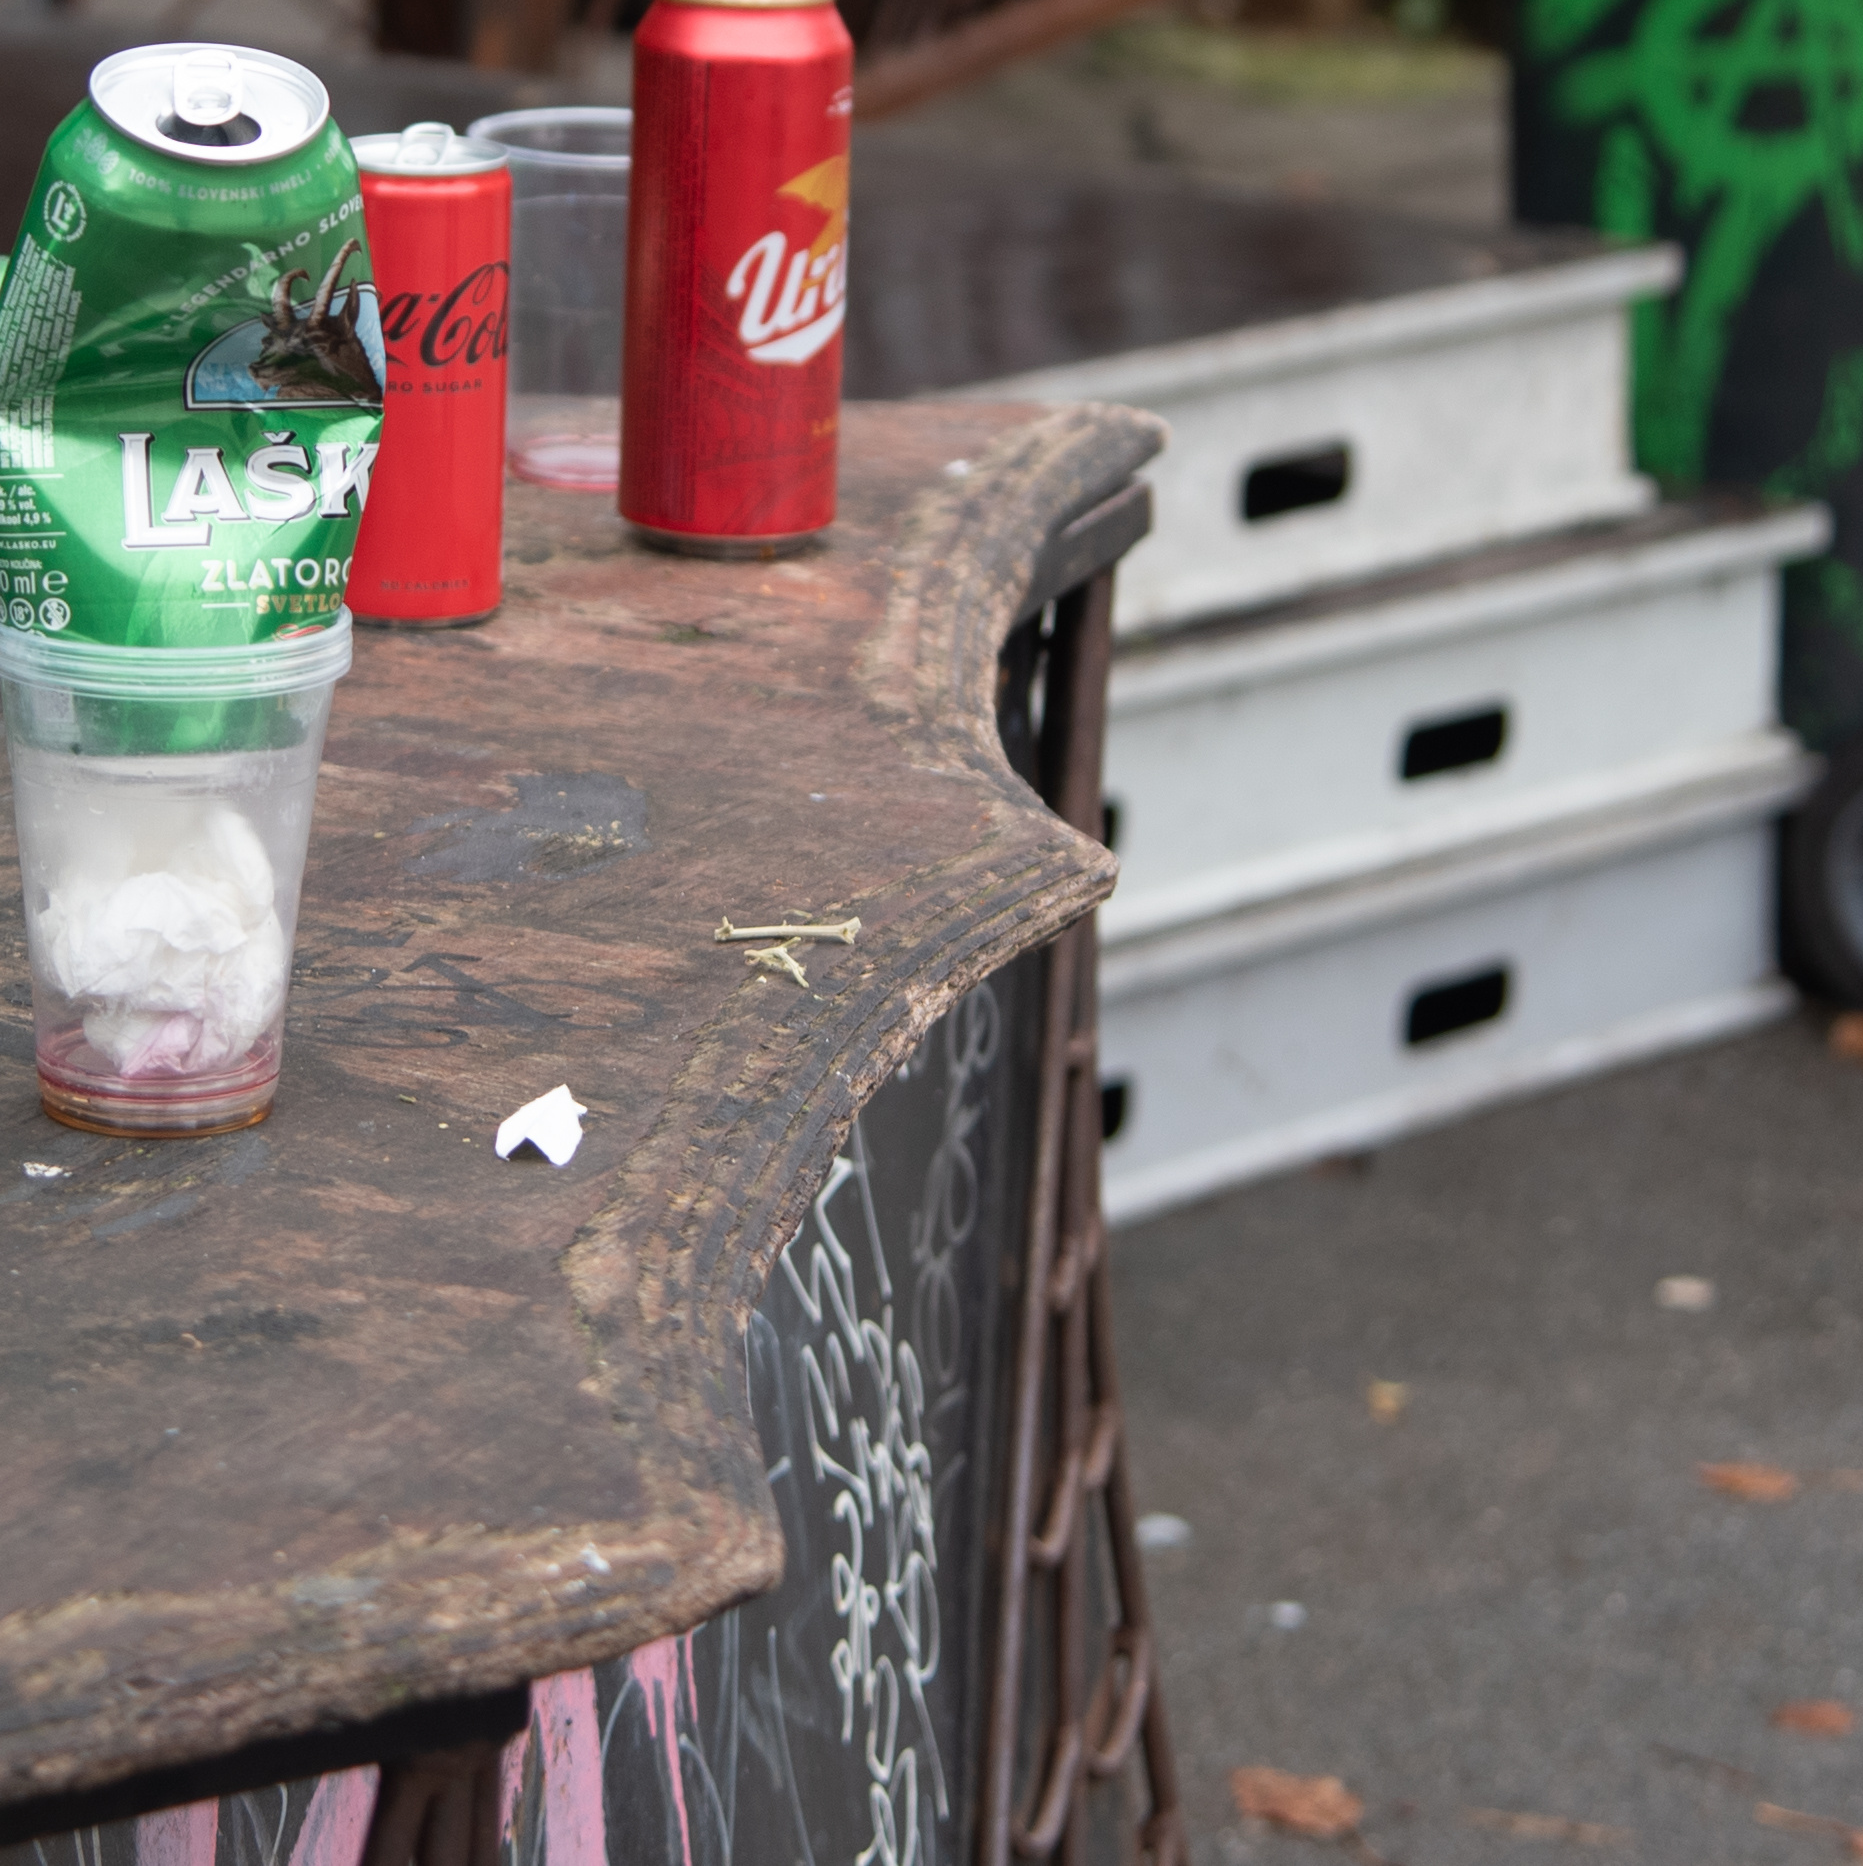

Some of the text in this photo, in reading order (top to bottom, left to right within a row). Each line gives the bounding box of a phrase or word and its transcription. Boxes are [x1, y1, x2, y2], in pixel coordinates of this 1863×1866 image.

[171, 231, 311, 322] LEGENDARNO
[118, 431, 382, 550] LAŠK
[13, 571, 35, 594] ml
[200, 557, 353, 592] ZLATOR
[255, 593, 343, 615] SVETLO
